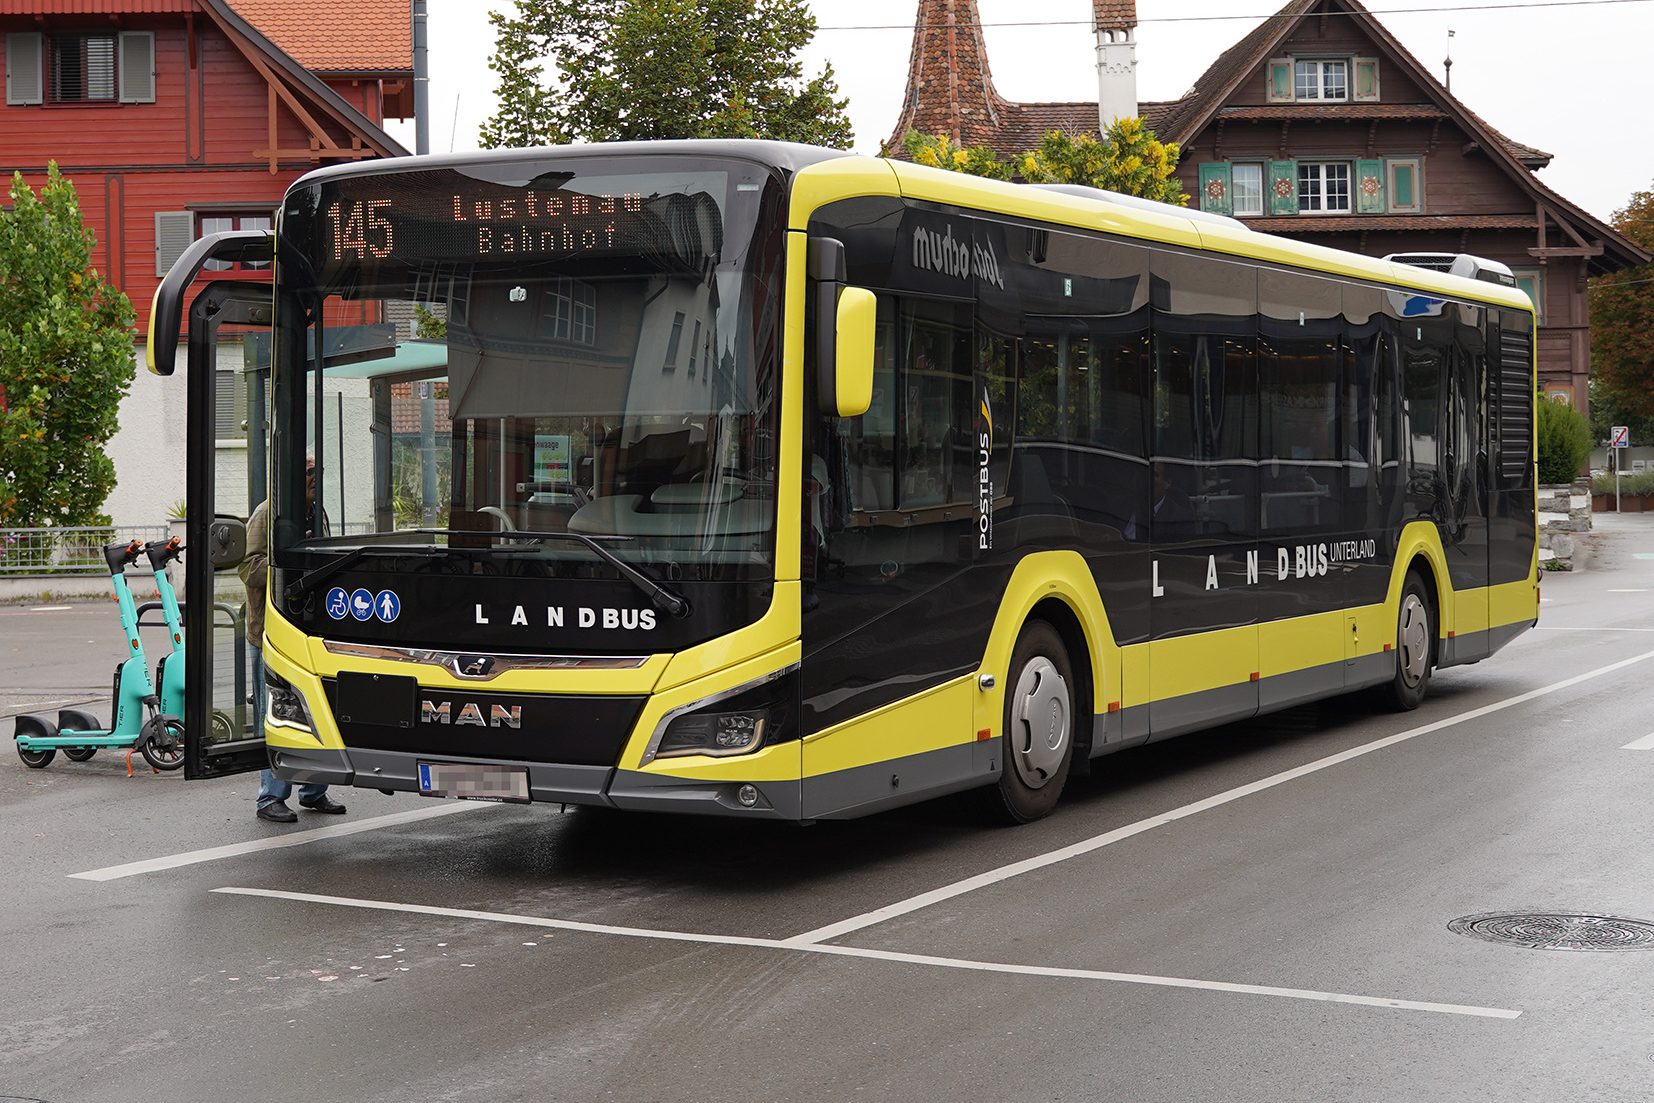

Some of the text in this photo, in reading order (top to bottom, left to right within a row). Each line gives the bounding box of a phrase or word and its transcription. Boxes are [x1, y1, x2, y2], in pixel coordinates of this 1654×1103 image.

[453, 191, 641, 221] Lustenau
[328, 199, 393, 259] 145
[479, 221, 615, 253] Bahnhof
[980, 433, 989, 549] POSTBUS
[1330, 539, 1376, 562] UNTERLAND
[421, 700, 522, 729] MAN
